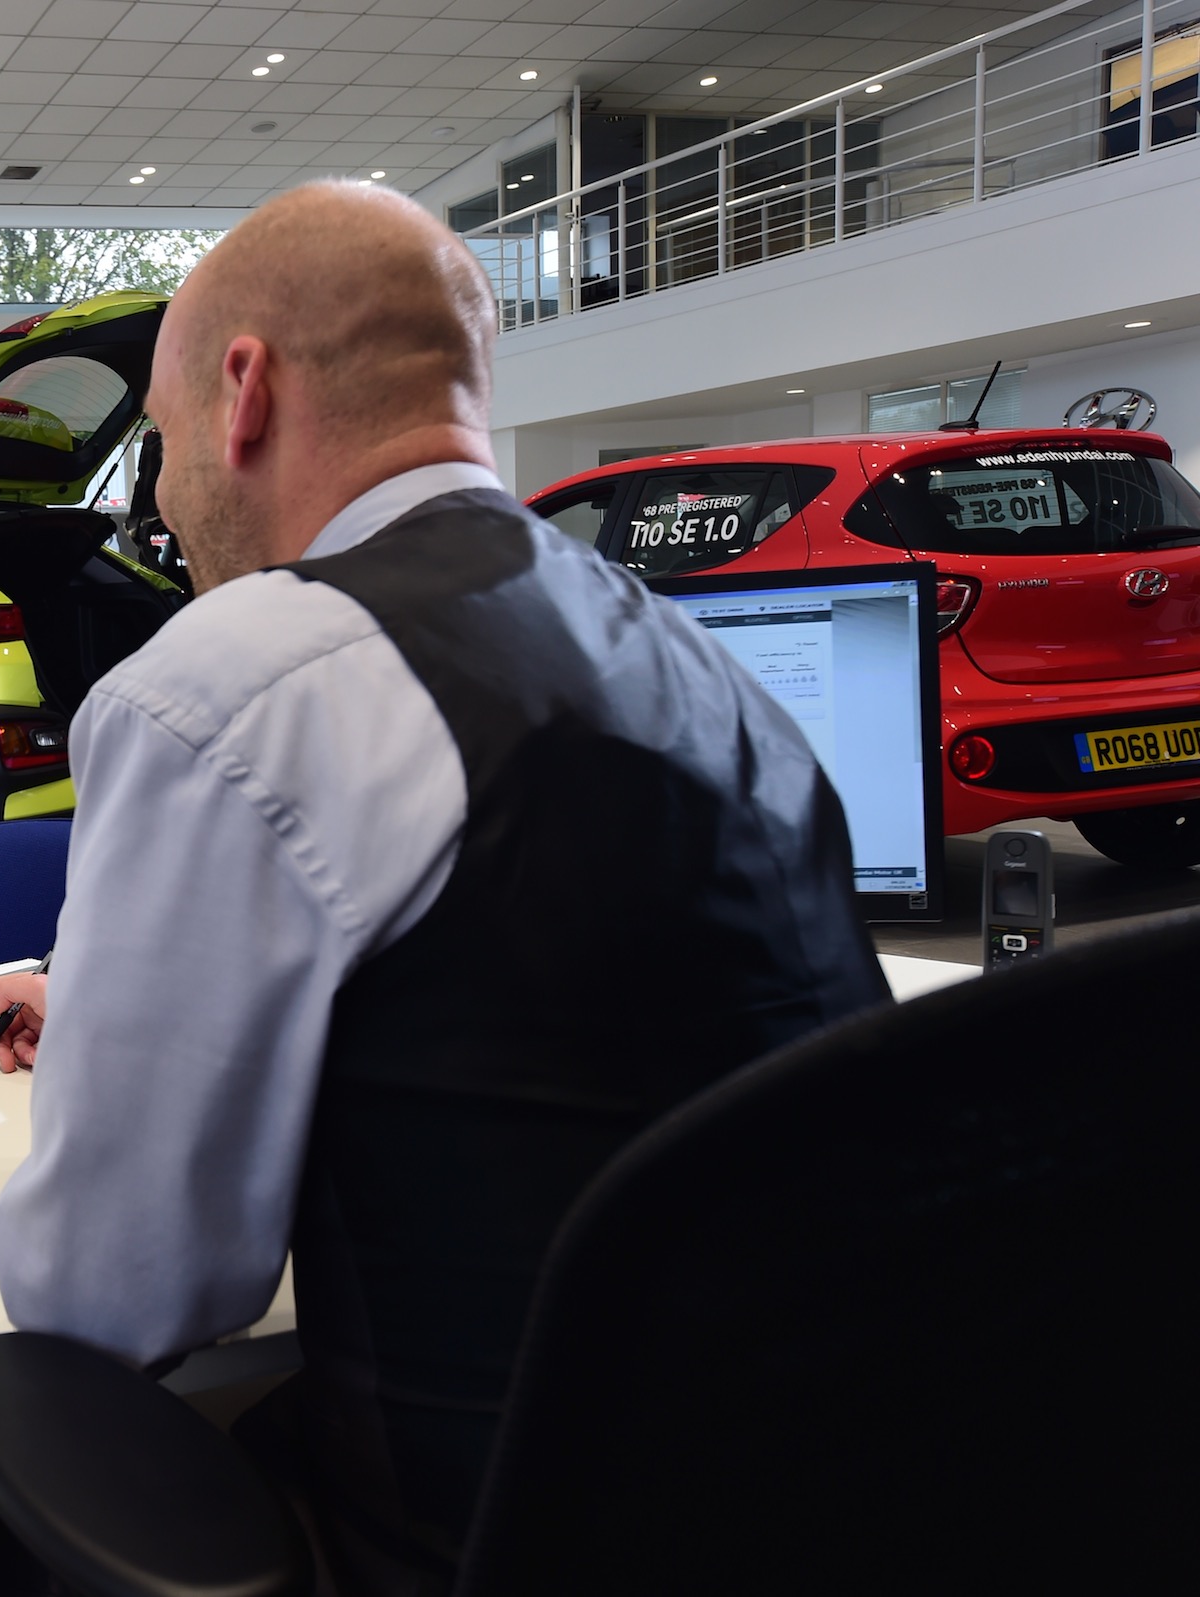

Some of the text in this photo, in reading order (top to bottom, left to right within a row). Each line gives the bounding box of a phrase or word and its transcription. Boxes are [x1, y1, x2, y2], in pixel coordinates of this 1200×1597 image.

[976, 449, 1136, 468] www.edenhyundai.com
[657, 496, 742, 514] PRE-REGISTERED
[667, 518, 700, 545] SE
[704, 514, 739, 542] 1.0
[1094, 732, 1160, 766] RO68
